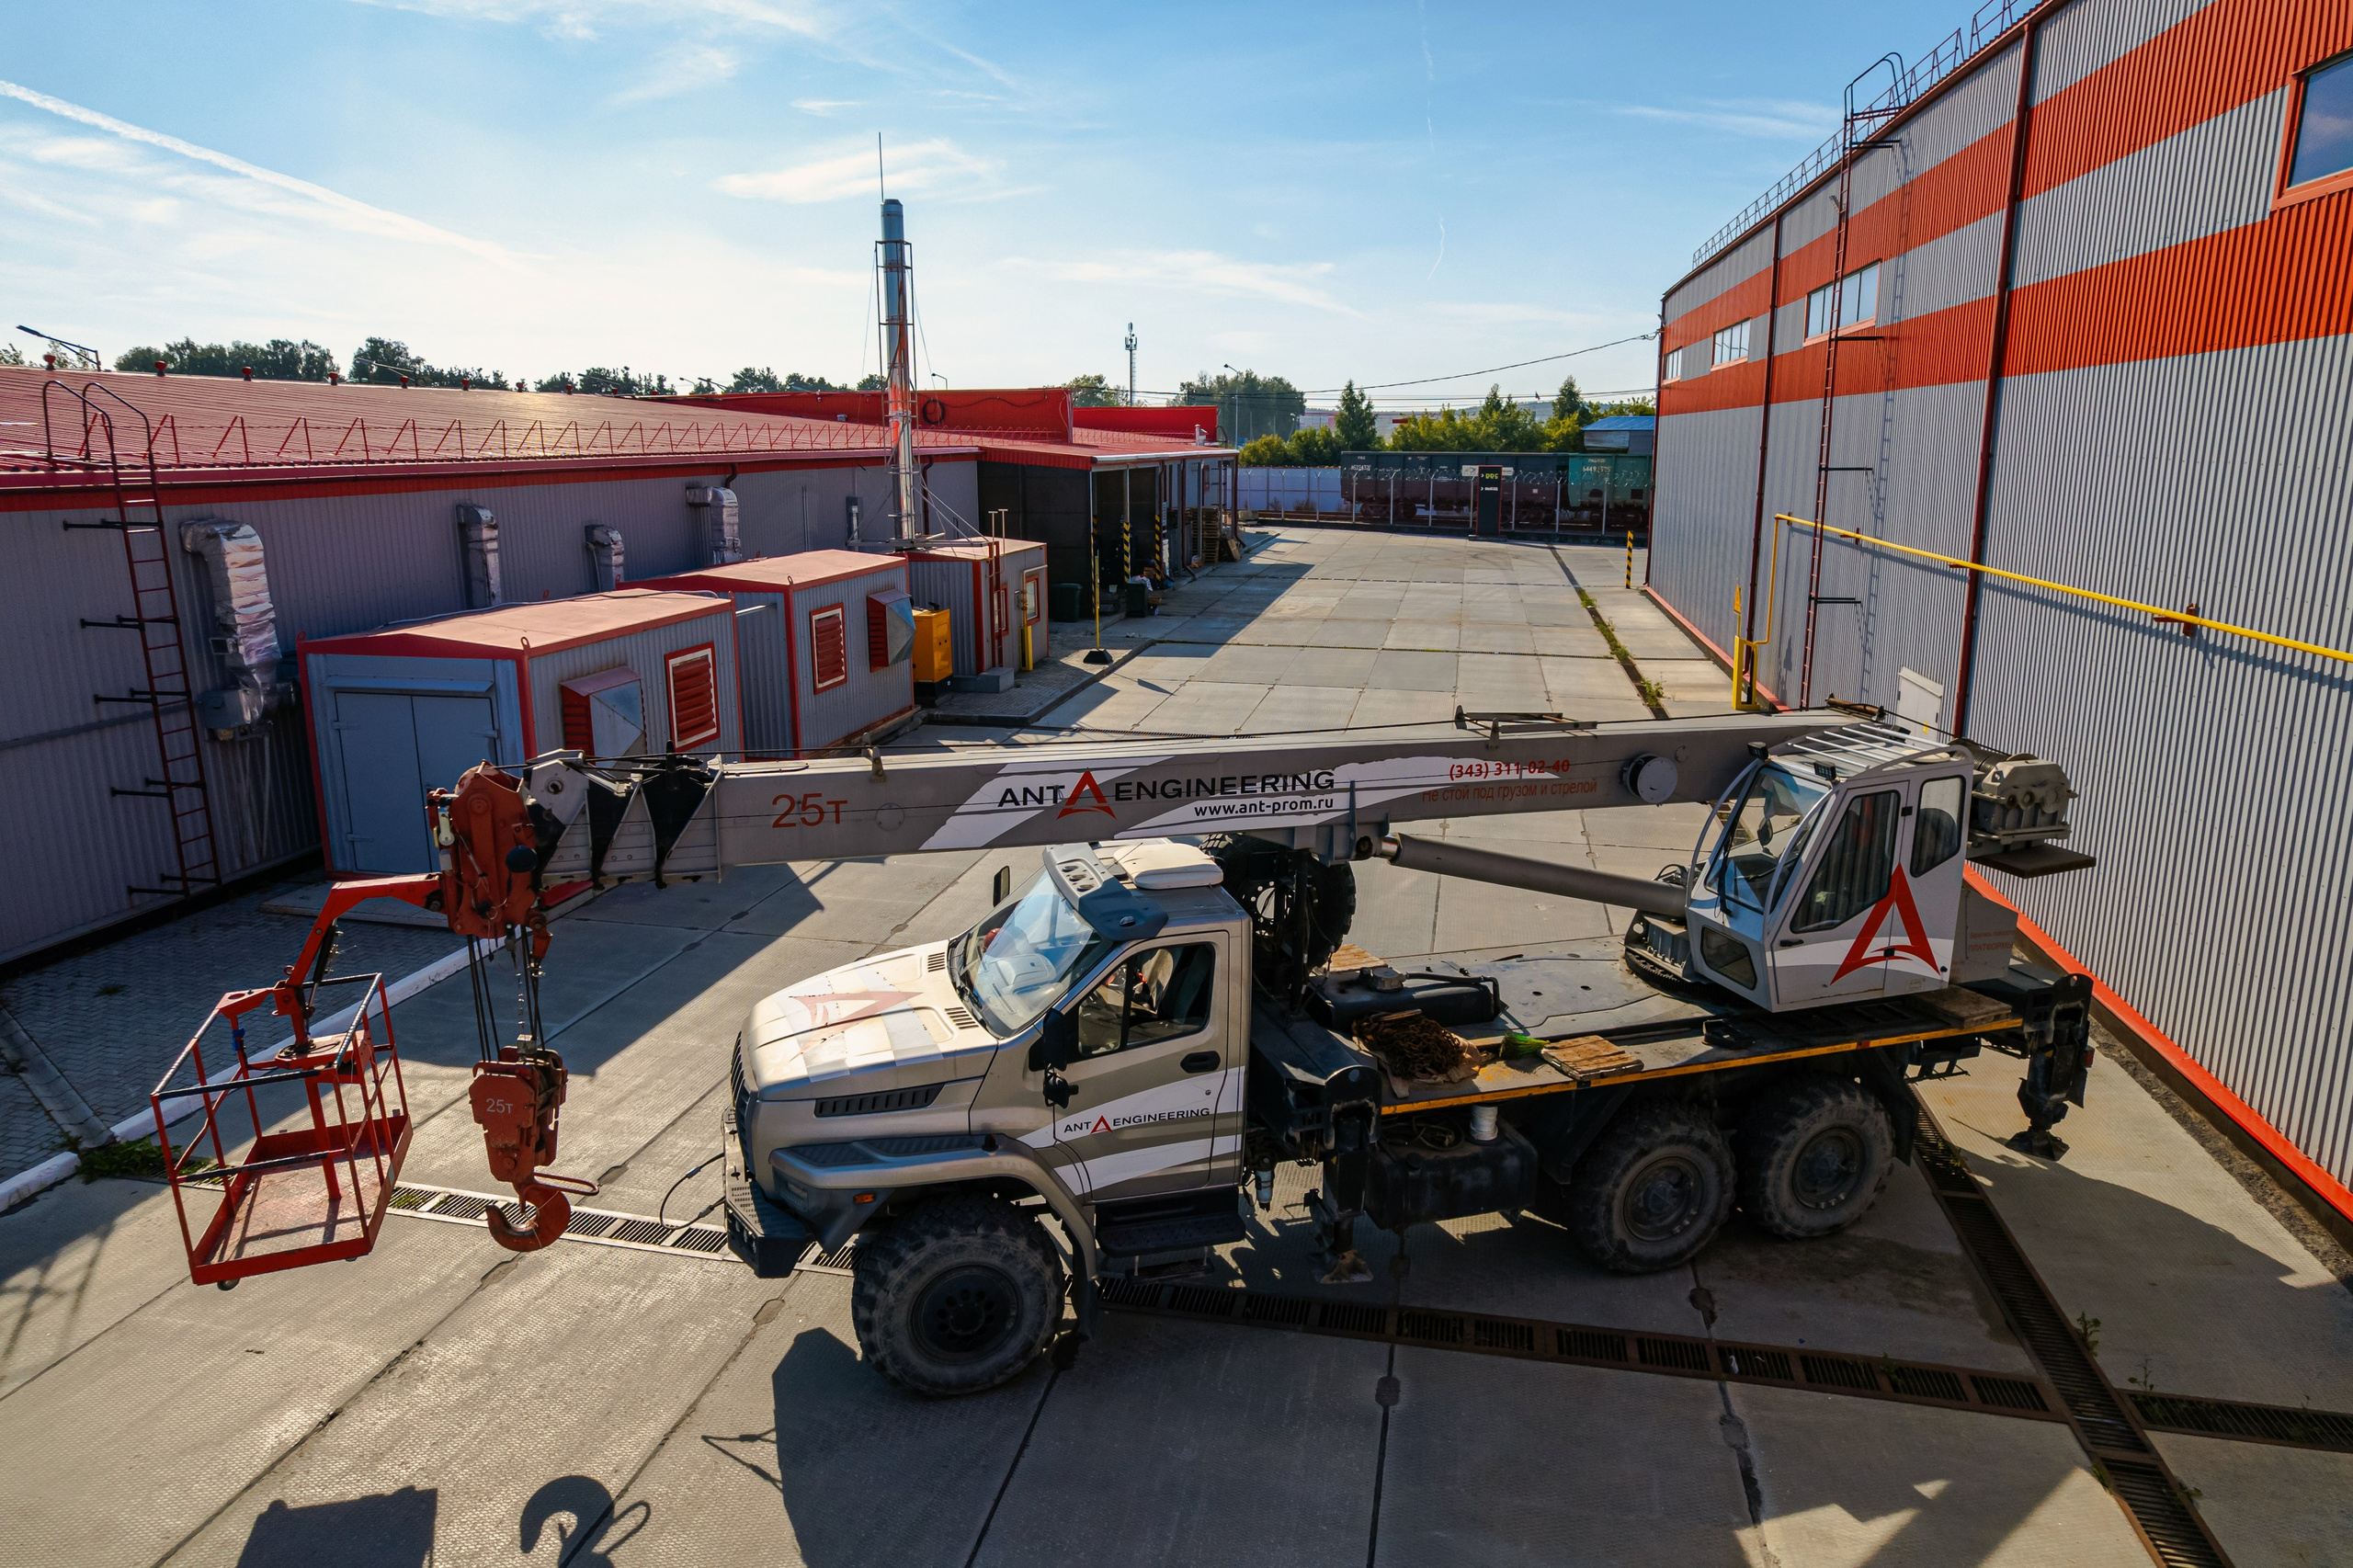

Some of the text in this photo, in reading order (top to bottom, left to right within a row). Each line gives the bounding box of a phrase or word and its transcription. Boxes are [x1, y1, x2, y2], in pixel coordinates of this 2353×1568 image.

[1449, 759, 1570, 781] (343) 311-02-40
[997, 771, 1335, 807] ANT ENGINEERING
[1442, 784, 1470, 801] стой
[1472, 787, 1495, 801] под
[1497, 785, 1537, 801] грузом
[1540, 784, 1548, 795] и
[1551, 778, 1597, 797] стрелой
[1195, 798, 1333, 816] www.ant-prom.ru
[1063, 1108, 1211, 1132] ANT ENGINEERING
